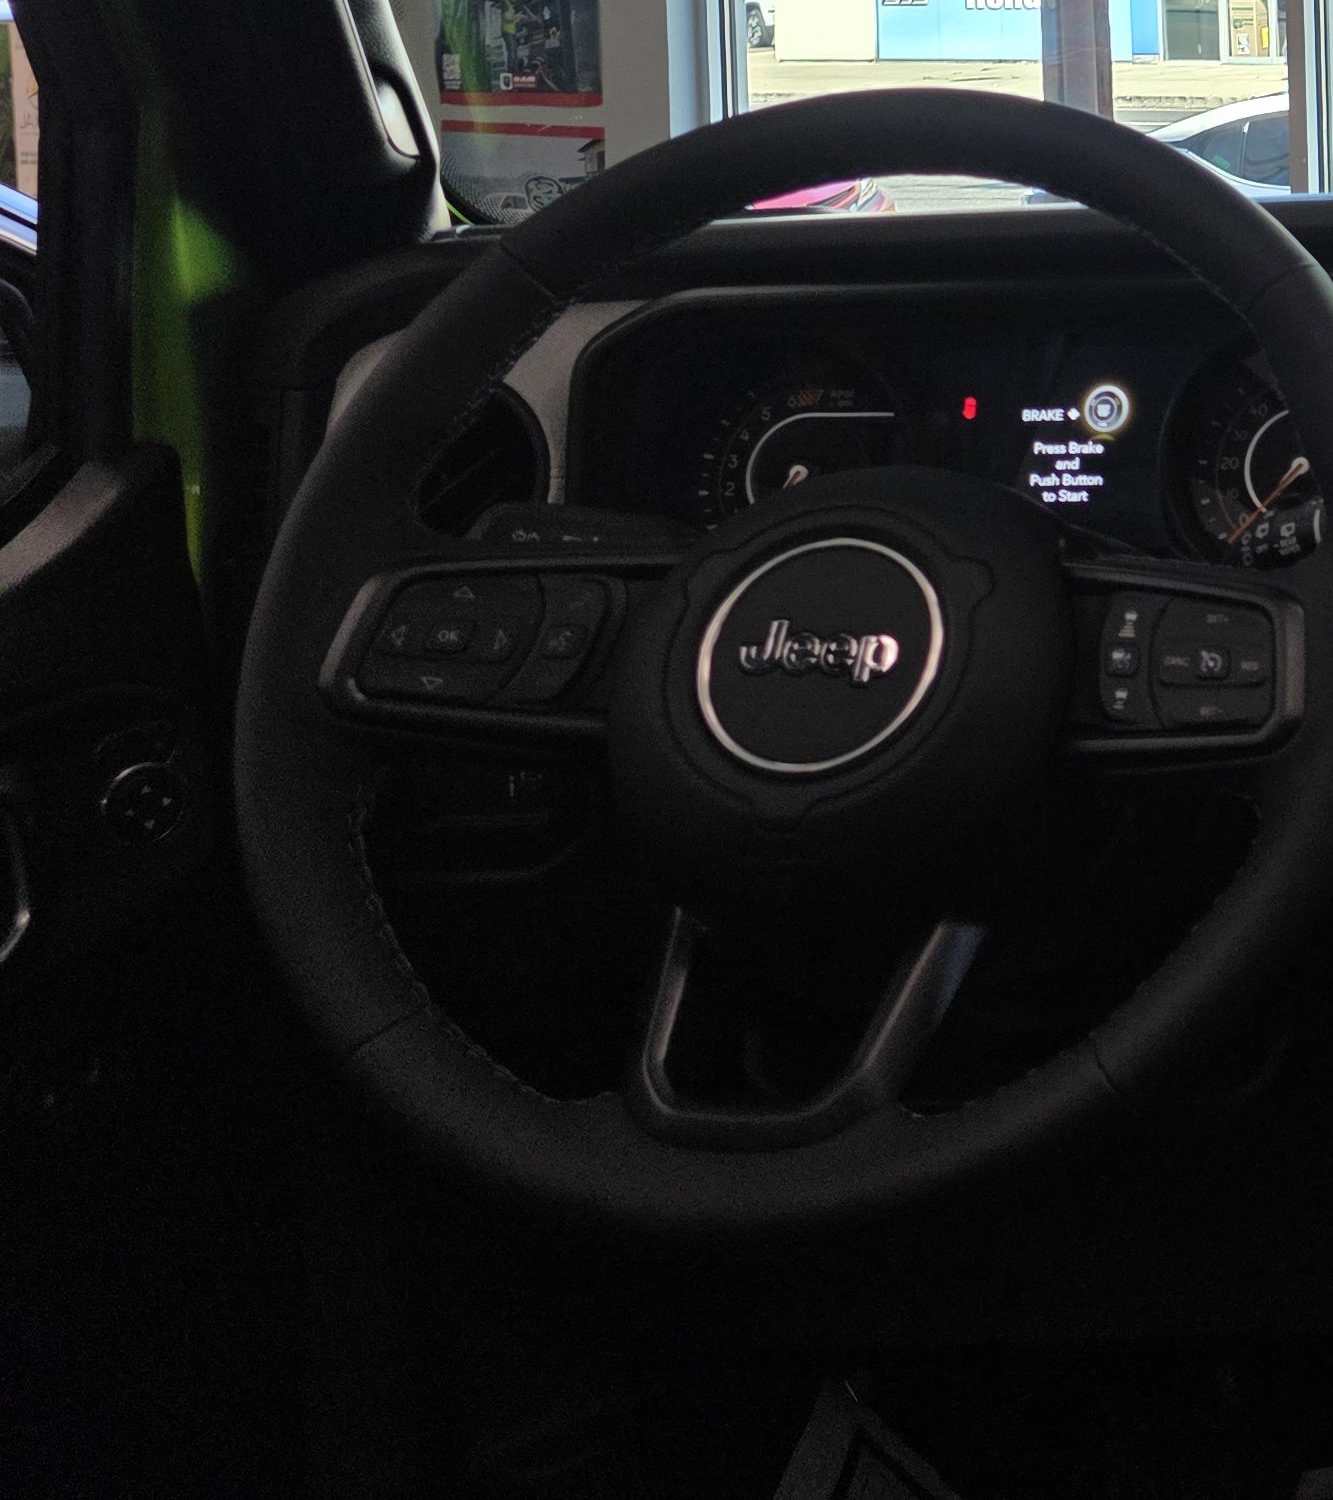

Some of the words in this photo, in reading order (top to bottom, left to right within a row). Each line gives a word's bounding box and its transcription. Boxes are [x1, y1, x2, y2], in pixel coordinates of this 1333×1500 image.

[760, 406, 772, 421] 5
[1022, 408, 1065, 421] BRAKE
[739, 428, 750, 442] 4
[1033, 441, 1067, 454] Press
[1068, 440, 1105, 454] Brake
[728, 453, 738, 468] 3
[1055, 457, 1080, 470] and
[1029, 473, 1060, 486] Push
[1062, 473, 1103, 486] Button
[724, 481, 735, 496] 2
[1042, 491, 1057, 503] to
[1058, 489, 1089, 502] Start
[438, 629, 459, 643] OK
[739, 619, 899, 683] Jeep
